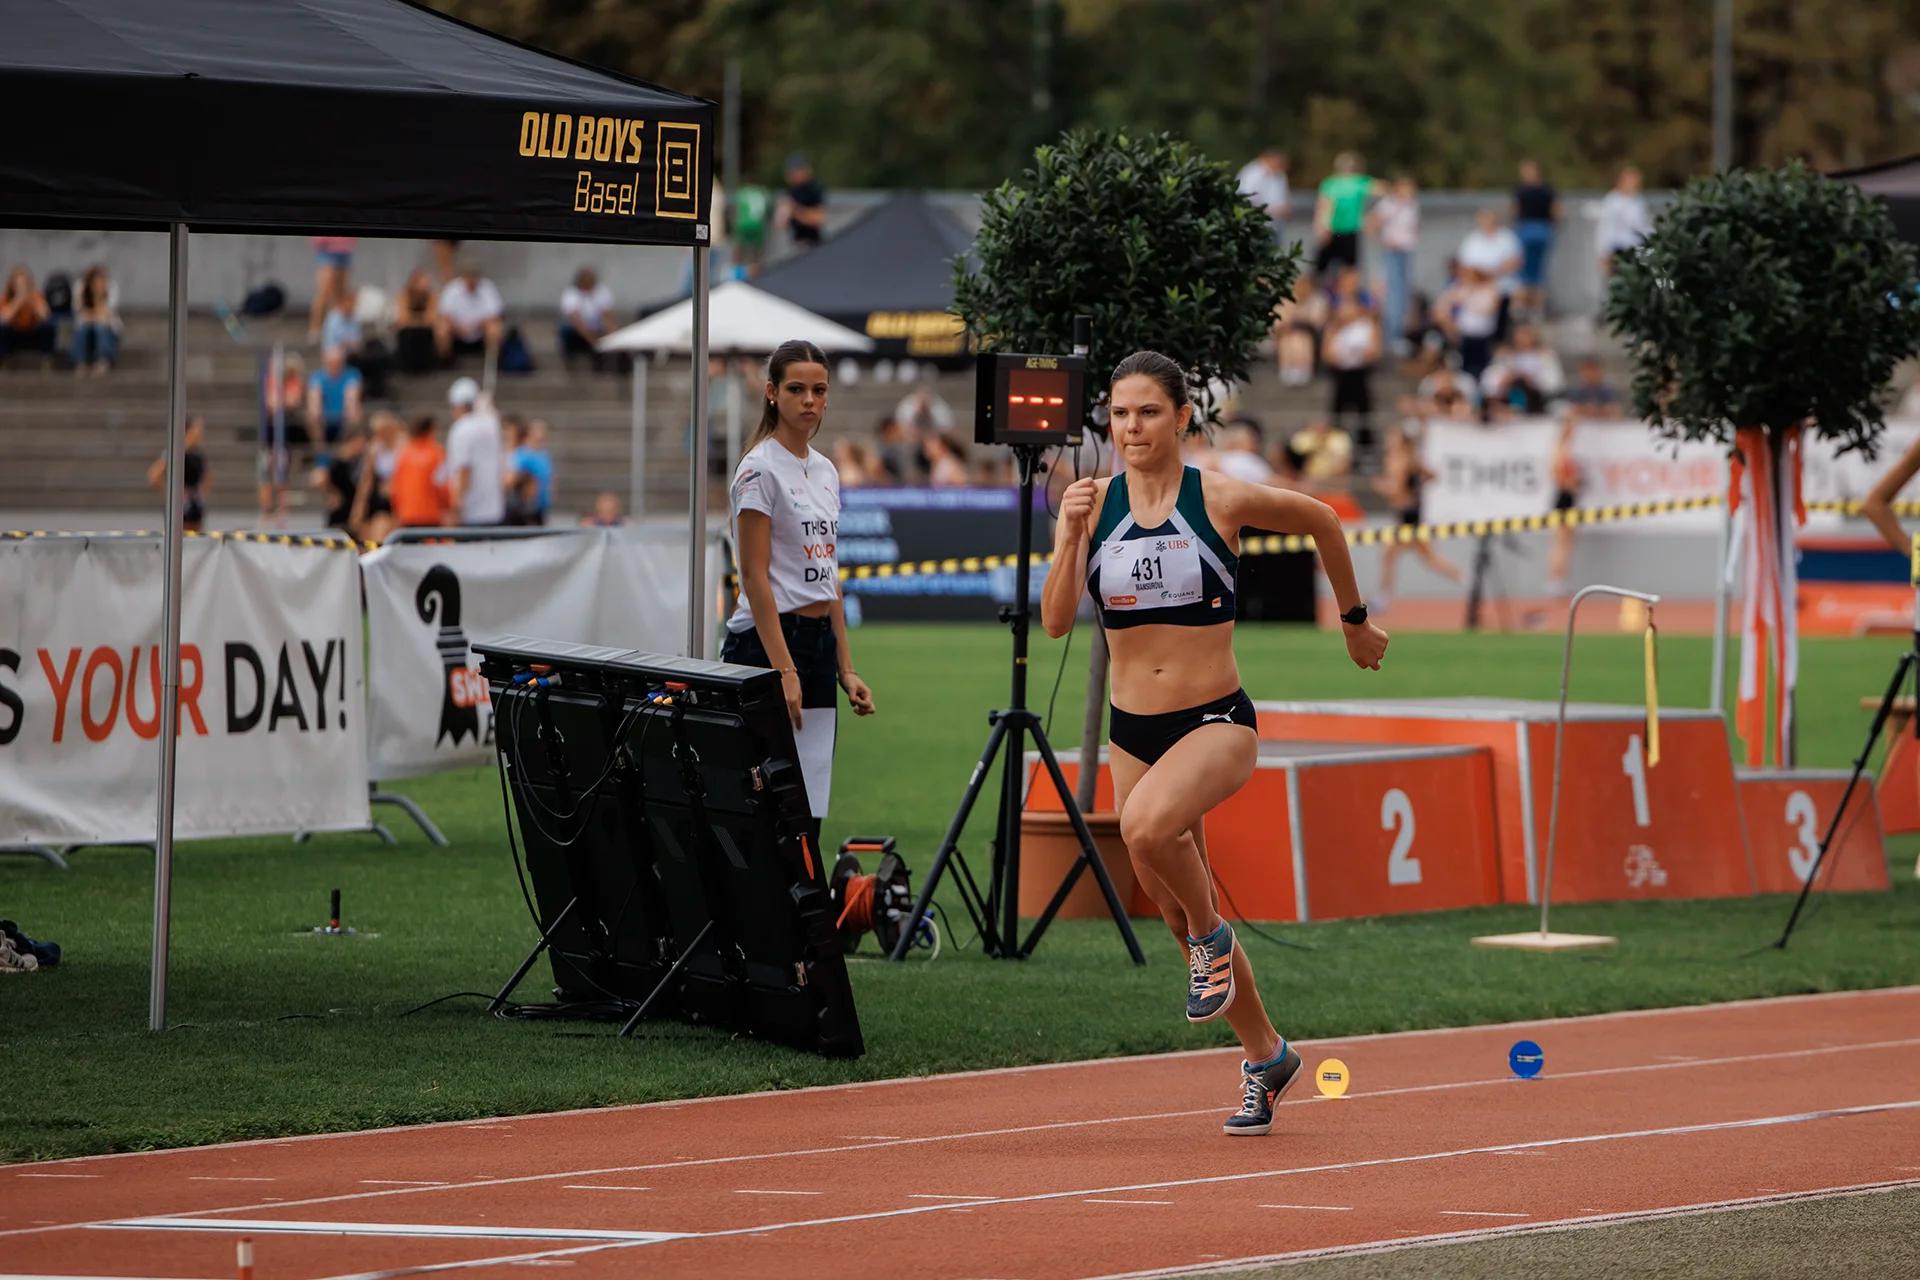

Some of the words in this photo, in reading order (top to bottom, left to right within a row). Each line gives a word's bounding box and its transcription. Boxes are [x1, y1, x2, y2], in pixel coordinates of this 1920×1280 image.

[519, 111, 573, 159] OLD
[574, 115, 645, 164] BOYS
[574, 170, 640, 215] Basel
[801, 520, 828, 536] THIS
[803, 543, 835, 560] YOUR
[1168, 540, 1189, 550] UBS
[1131, 556, 1163, 582] 431
[37, 643, 209, 744] YOUR
[224, 637, 348, 734] DAY!
[1622, 734, 1651, 827] 1
[1381, 789, 1422, 885] 2
[1785, 791, 1820, 882] 3
